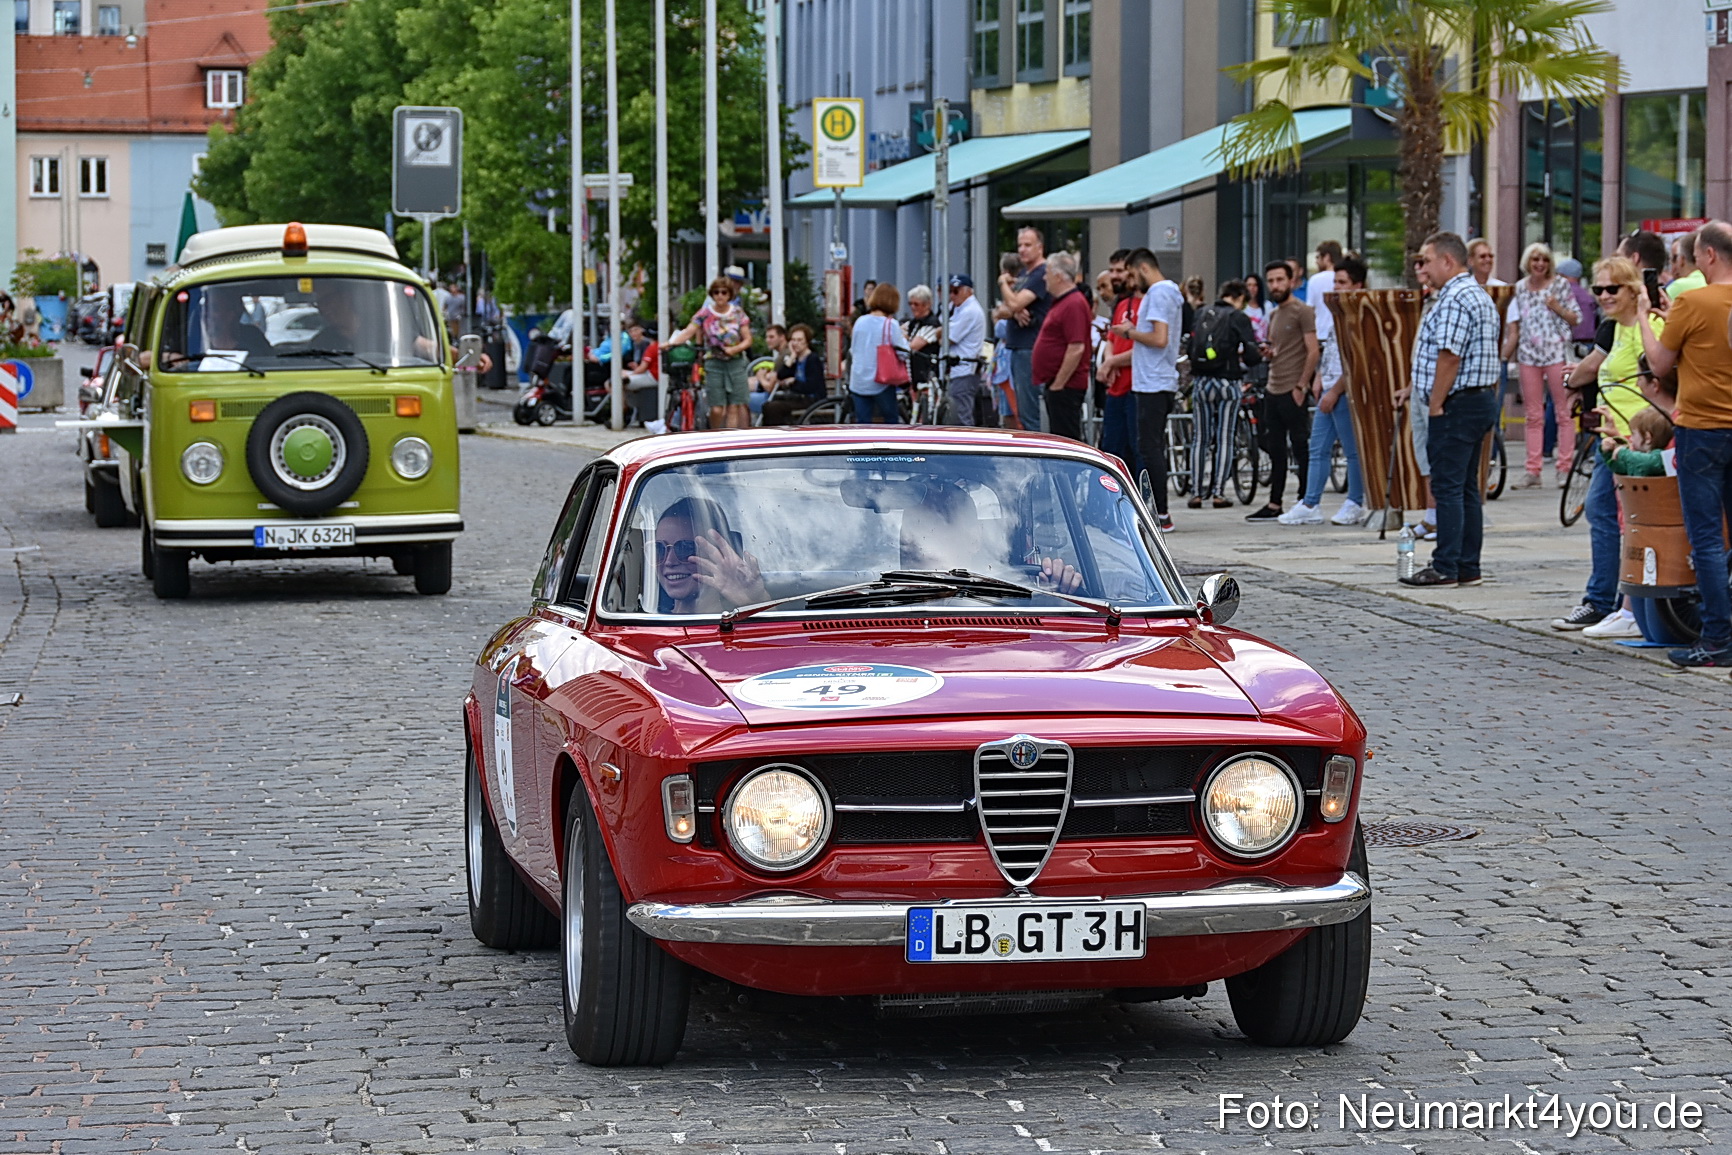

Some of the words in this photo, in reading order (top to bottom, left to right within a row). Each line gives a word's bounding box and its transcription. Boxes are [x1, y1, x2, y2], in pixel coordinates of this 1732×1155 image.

[831, 112, 846, 133] H
[264, 528, 276, 544] N
[287, 528, 308, 544] JK
[311, 527, 353, 543] 632H
[802, 684, 867, 695] 49
[915, 940, 925, 952] D
[935, 914, 991, 955] LB
[1017, 911, 1073, 953] GT
[1082, 910, 1142, 952] 3H
